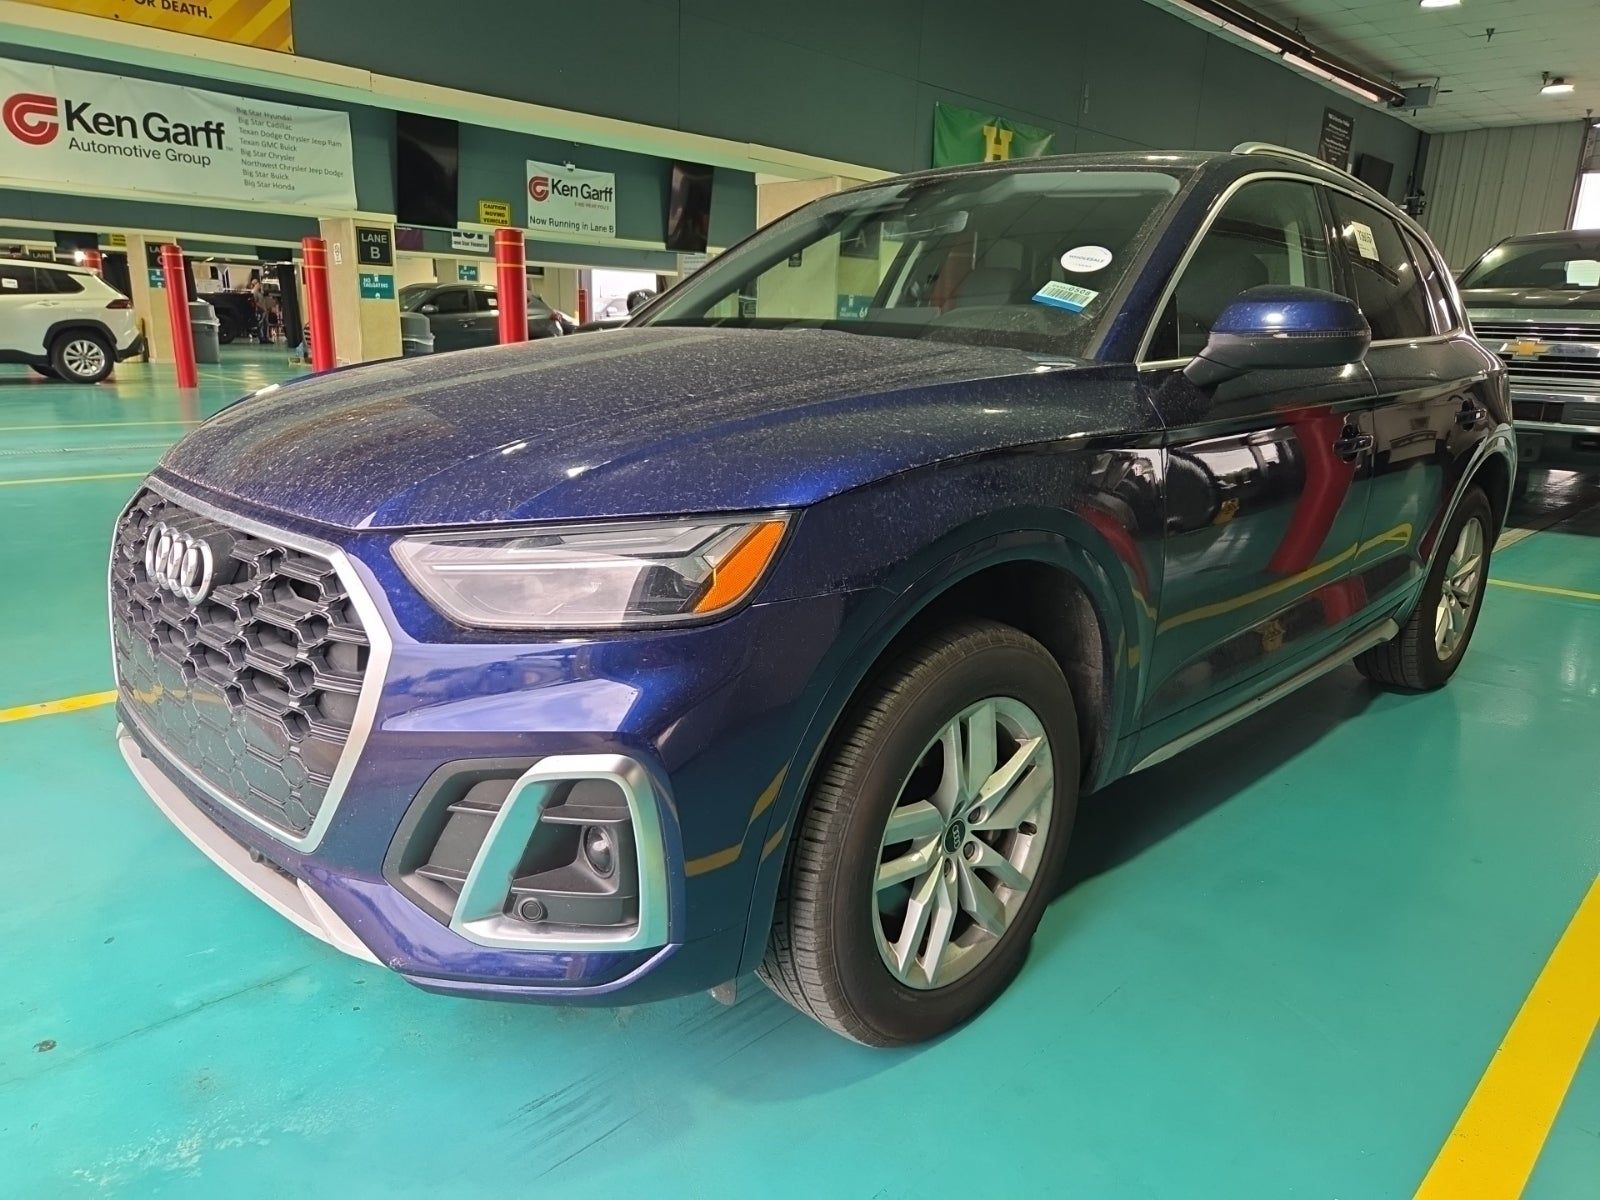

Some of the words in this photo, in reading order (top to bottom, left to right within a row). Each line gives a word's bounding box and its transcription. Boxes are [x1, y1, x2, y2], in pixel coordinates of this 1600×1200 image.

[161, 0, 213, 19] DEATH.
[236, 106, 248, 116] Big
[248, 109, 262, 117] Star
[264, 111, 293, 122] Hyundai
[64, 99, 138, 139] Ken
[142, 111, 226, 150] Garff
[238, 116, 249, 126] Big
[251, 118, 265, 127] Star
[266, 121, 293, 131] Cadillac
[239, 127, 259, 136] Texan
[260, 130, 282, 141] Dodge
[283, 133, 310, 144] Chrysler
[311, 138, 327, 147] Jeep
[327, 139, 342, 148] Ram
[240, 137, 260, 147] Texan
[261, 140, 278, 150] GMC
[280, 142, 297, 152] Buick
[69, 136, 161, 160] Automotive
[165, 148, 211, 168] Group
[240, 148, 252, 158] Big
[252, 150, 267, 159] Star
[268, 151, 295, 162] Chrysler
[241, 159, 278, 169] Northwest
[279, 163, 307, 174] Chrysler
[308, 167, 323, 176] Jeep
[324, 168, 344, 179] Dodge
[242, 169, 254, 179] Big
[255, 170, 269, 179] Star
[270, 172, 289, 181] Buick
[243, 179, 256, 190] Big
[257, 180, 271, 189] Star
[272, 182, 295, 192] Honda
[551, 178, 579, 199] Ken
[580, 183, 613, 203] Garff
[529, 215, 547, 226] Now
[548, 217, 580, 232] Running
[581, 222, 588, 231] in
[590, 222, 608, 233] Lane
[609, 225, 615, 233] B
[361, 232, 387, 244] LANE
[370, 246, 381, 259] B
